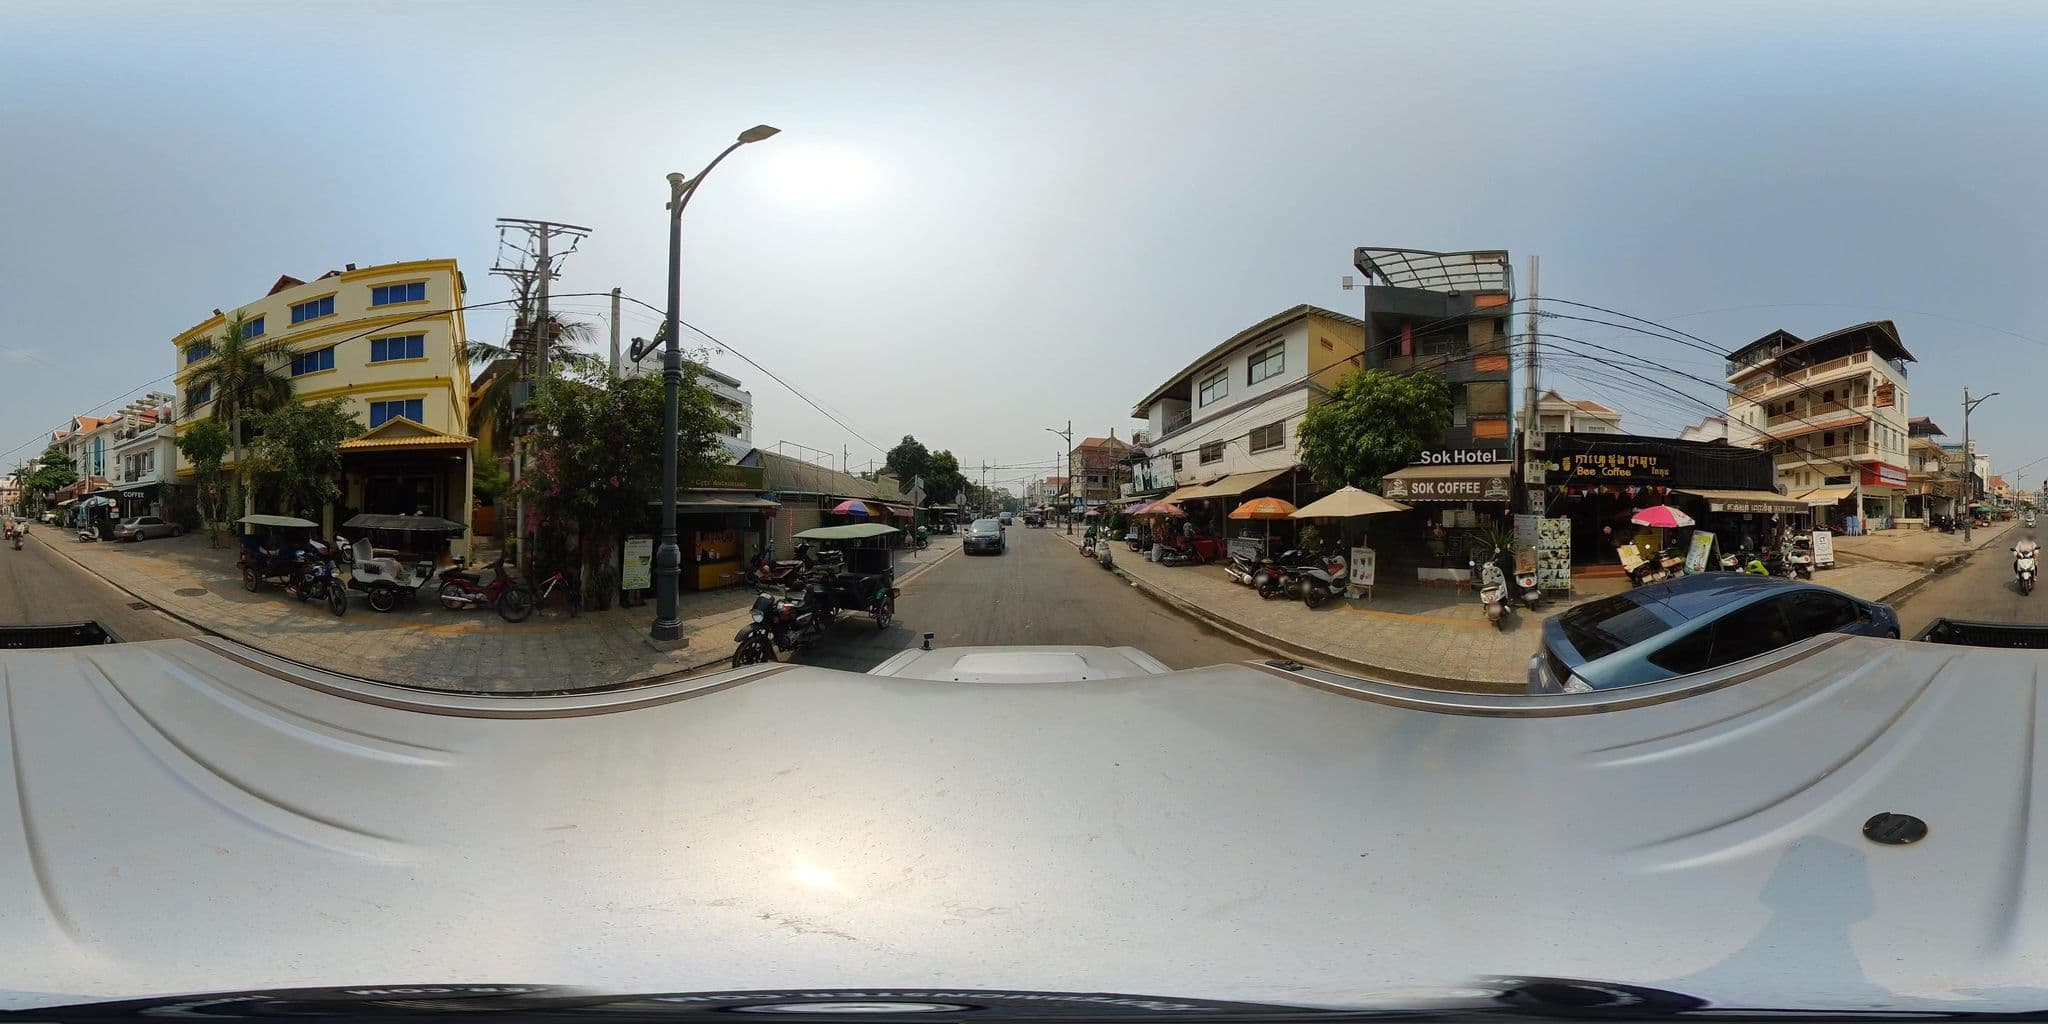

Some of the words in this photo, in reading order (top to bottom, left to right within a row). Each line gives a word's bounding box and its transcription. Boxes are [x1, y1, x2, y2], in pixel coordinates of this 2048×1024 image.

[1421, 450, 1451, 464] Sok
[1454, 449, 1497, 463] Hotel
[1577, 467, 1596, 476] Bee
[1602, 467, 1632, 477] Coffee
[1411, 482, 1434, 494] SOK
[1437, 482, 1481, 494] COFFEE
